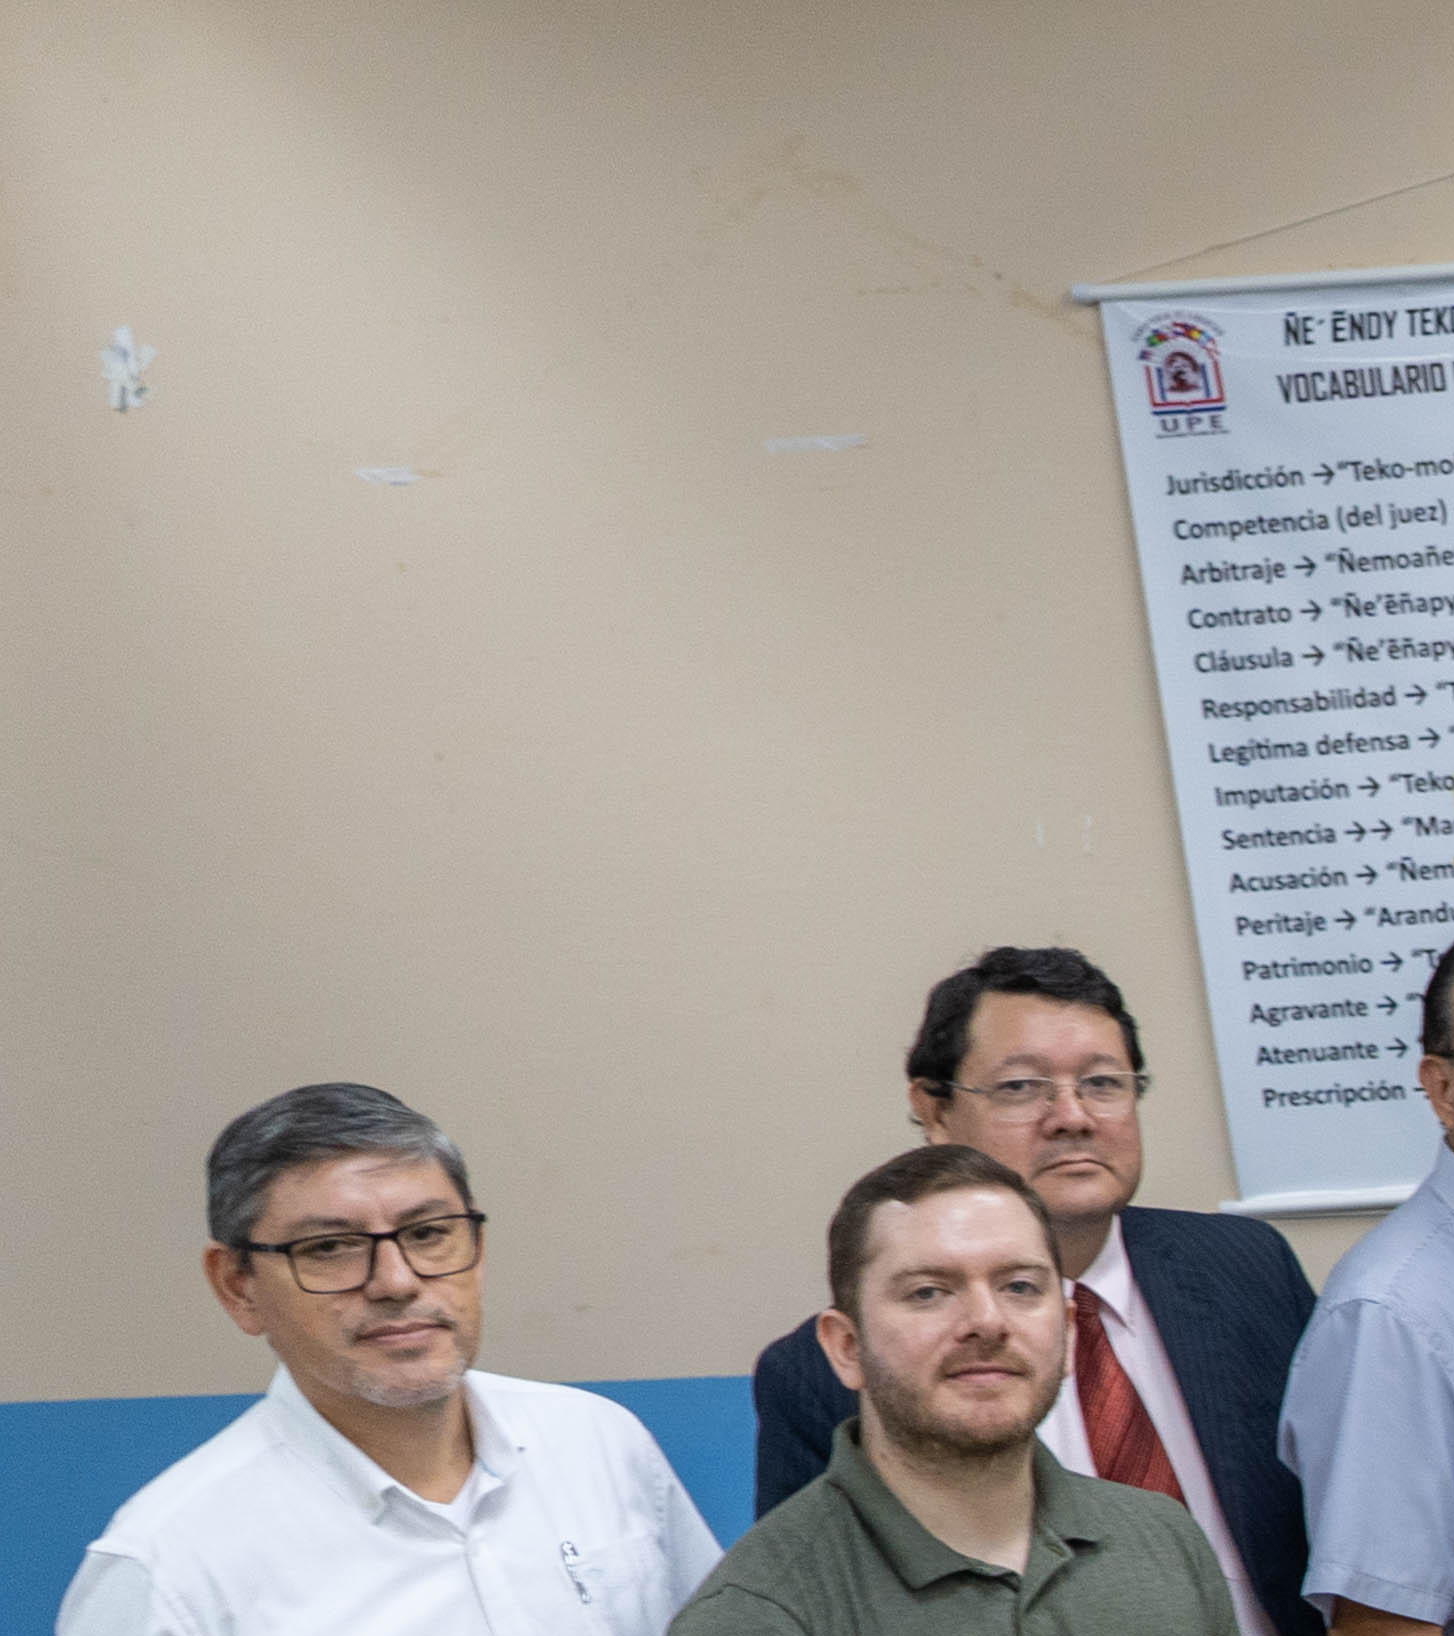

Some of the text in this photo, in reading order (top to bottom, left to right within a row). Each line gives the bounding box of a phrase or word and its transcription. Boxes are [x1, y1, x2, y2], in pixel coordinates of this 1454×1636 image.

[1276, 363, 1447, 404] VOCABULARIO
[1166, 465, 1305, 496] Jurisdicción
[1173, 509, 1329, 541] Competencia
[1337, 503, 1382, 533] (del
[1390, 499, 1448, 530] juez)
[1180, 557, 1286, 585] Arbitraje
[1188, 604, 1292, 629] Contrato
[1194, 647, 1294, 673] Cláusula
[1201, 685, 1397, 720] Responsabilidad
[1208, 739, 1309, 766] Legítima
[1316, 731, 1410, 756] defensa
[1214, 779, 1349, 809] Imputación
[1221, 824, 1337, 851] Sentencia
[1229, 863, 1348, 893] Acusación
[1235, 912, 1327, 938] Peritaje
[1241, 954, 1374, 981] Patrimonio
[1250, 999, 1369, 1027] Agravante
[1256, 1040, 1379, 1066] Atenuante
[1262, 1080, 1406, 1108] Prescripción
